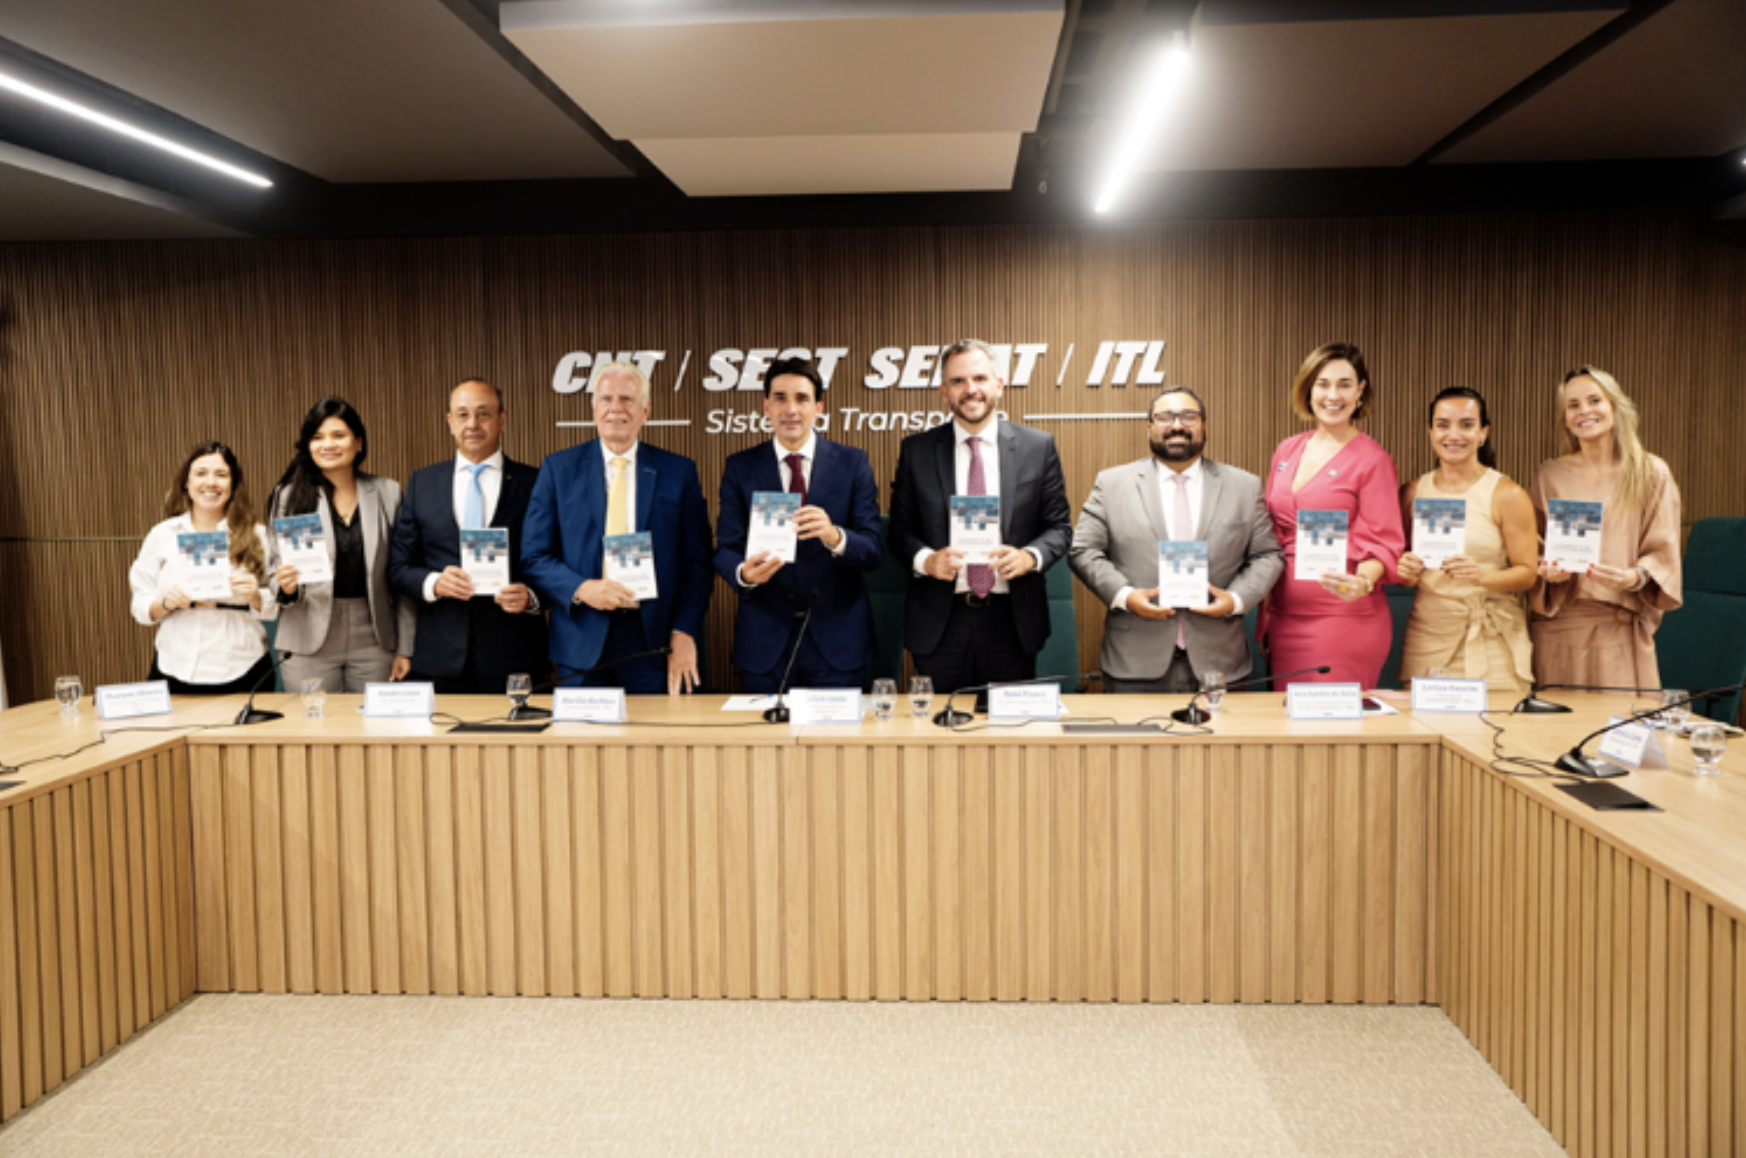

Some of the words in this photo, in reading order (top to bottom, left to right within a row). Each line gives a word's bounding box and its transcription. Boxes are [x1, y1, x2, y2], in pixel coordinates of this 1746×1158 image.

[702, 347, 848, 392] SET
[863, 343, 1048, 389] SET
[1086, 340, 1165, 385] ITL
[705, 408, 831, 434] Sistea
[839, 407, 1009, 432] Transp
